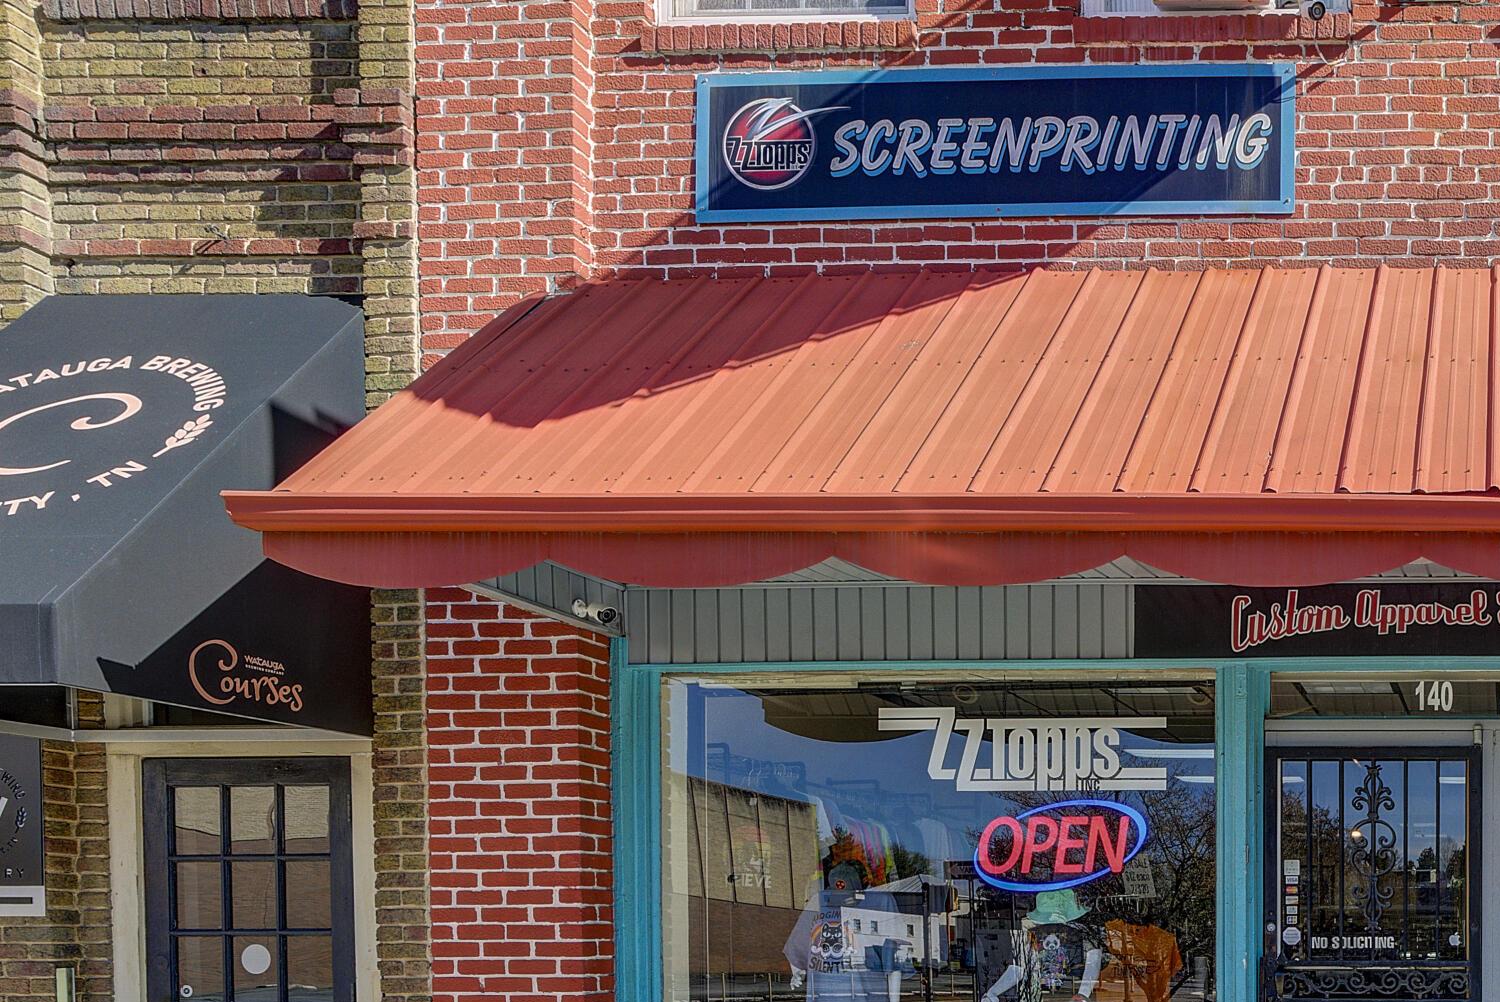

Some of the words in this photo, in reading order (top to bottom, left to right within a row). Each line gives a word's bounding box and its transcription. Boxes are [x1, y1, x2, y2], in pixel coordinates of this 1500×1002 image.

[830, 113, 1273, 177] SCREENPRINTING
[0, 356, 133, 393] ATAUGA
[139, 355, 226, 412] BREWING
[0, 491, 55, 516] TY
[86, 460, 148, 487] TN
[1231, 590, 1350, 652] Custom
[1354, 590, 1491, 635] Apparel
[189, 639, 303, 712] Courses
[1414, 680, 1454, 711] 140
[978, 815, 1131, 875] OPEN
[1311, 936, 1328, 949] NO
